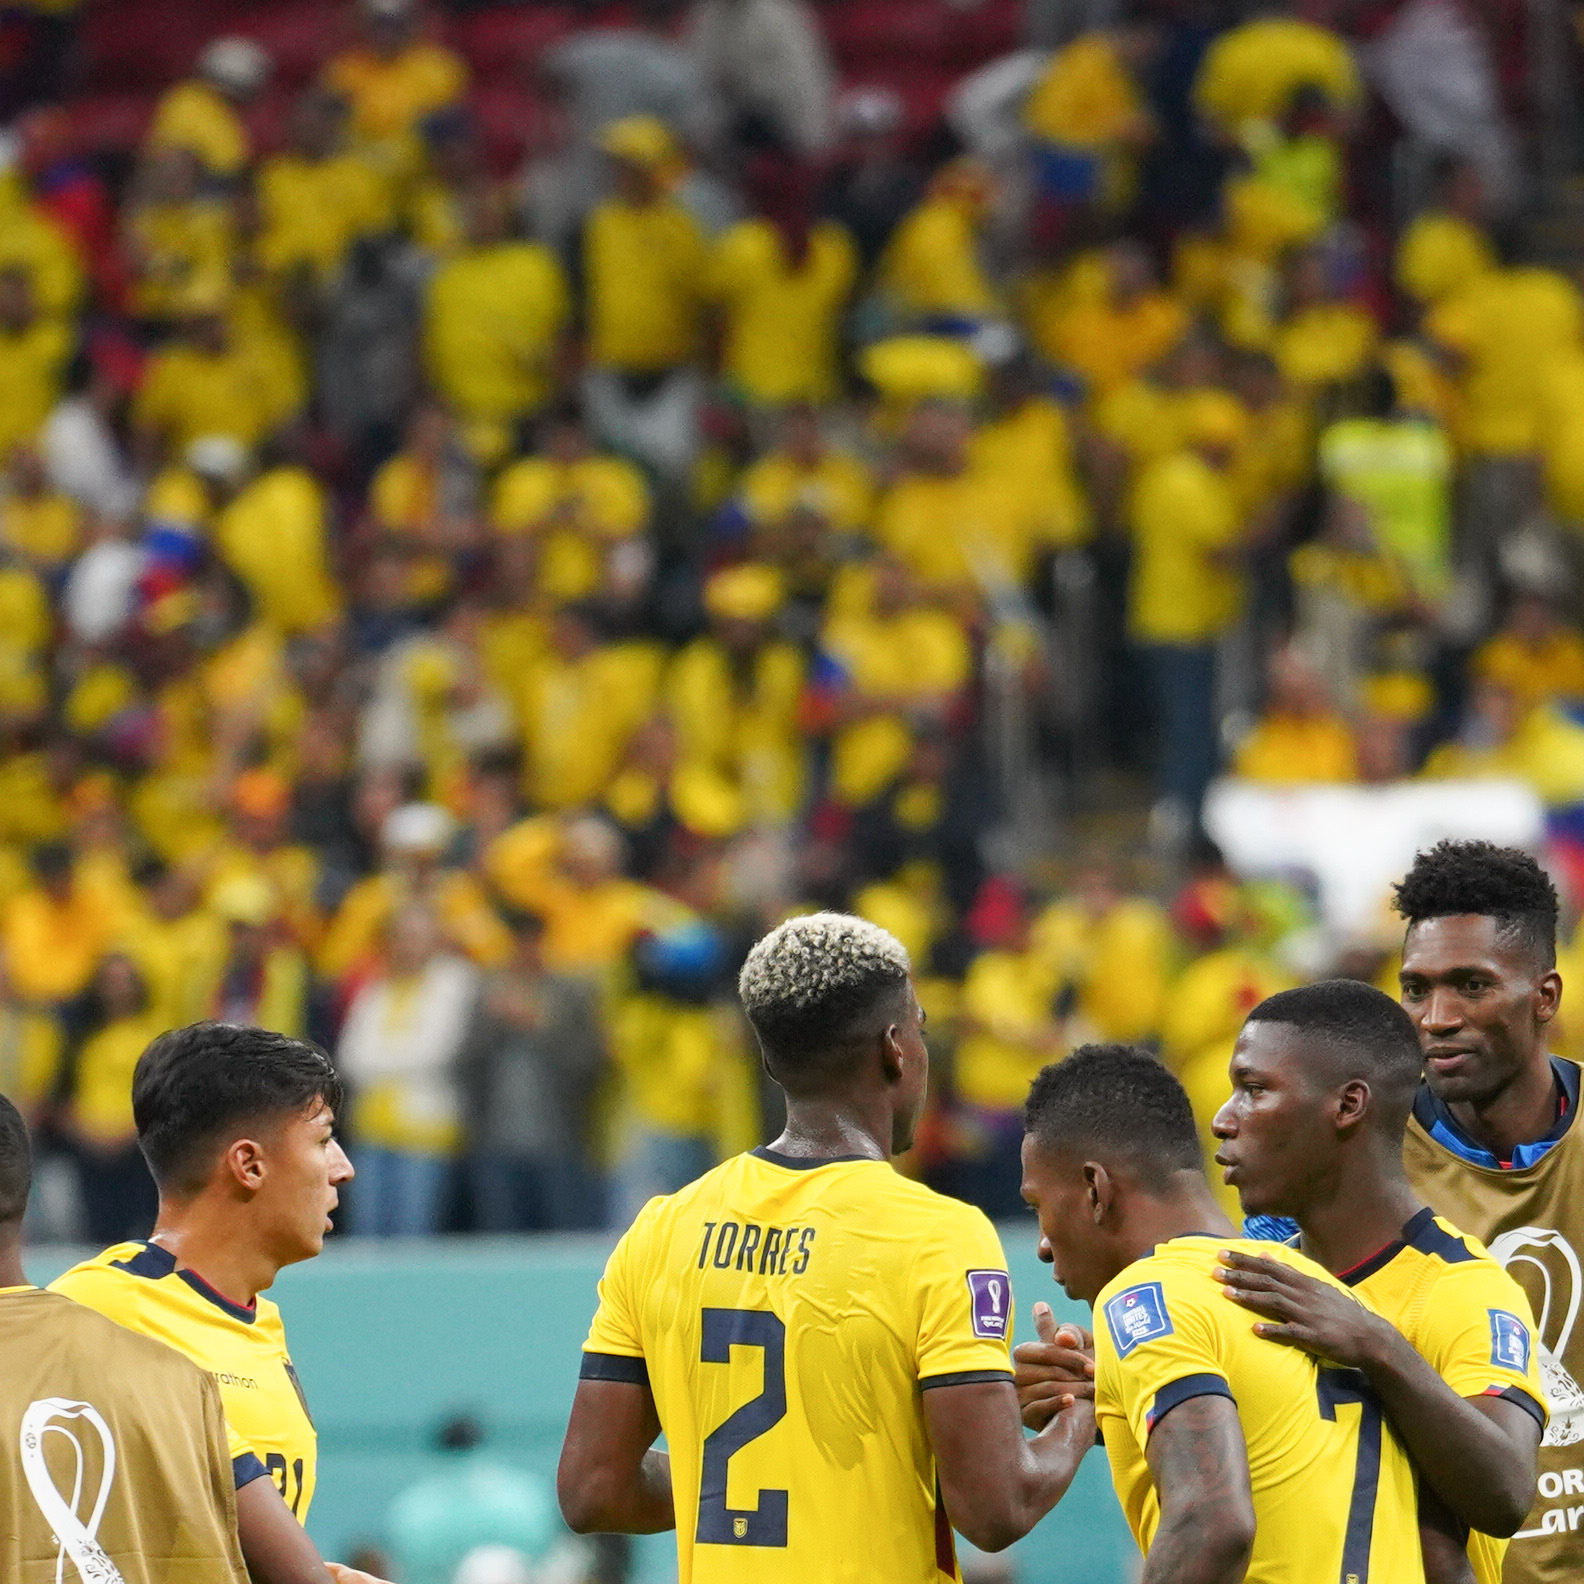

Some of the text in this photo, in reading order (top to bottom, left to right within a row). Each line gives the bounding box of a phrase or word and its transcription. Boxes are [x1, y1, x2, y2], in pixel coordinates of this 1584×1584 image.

[699, 1221, 816, 1276] TORRES
[215, 1371, 260, 1391] rathon
[695, 1307, 789, 1548] 2
